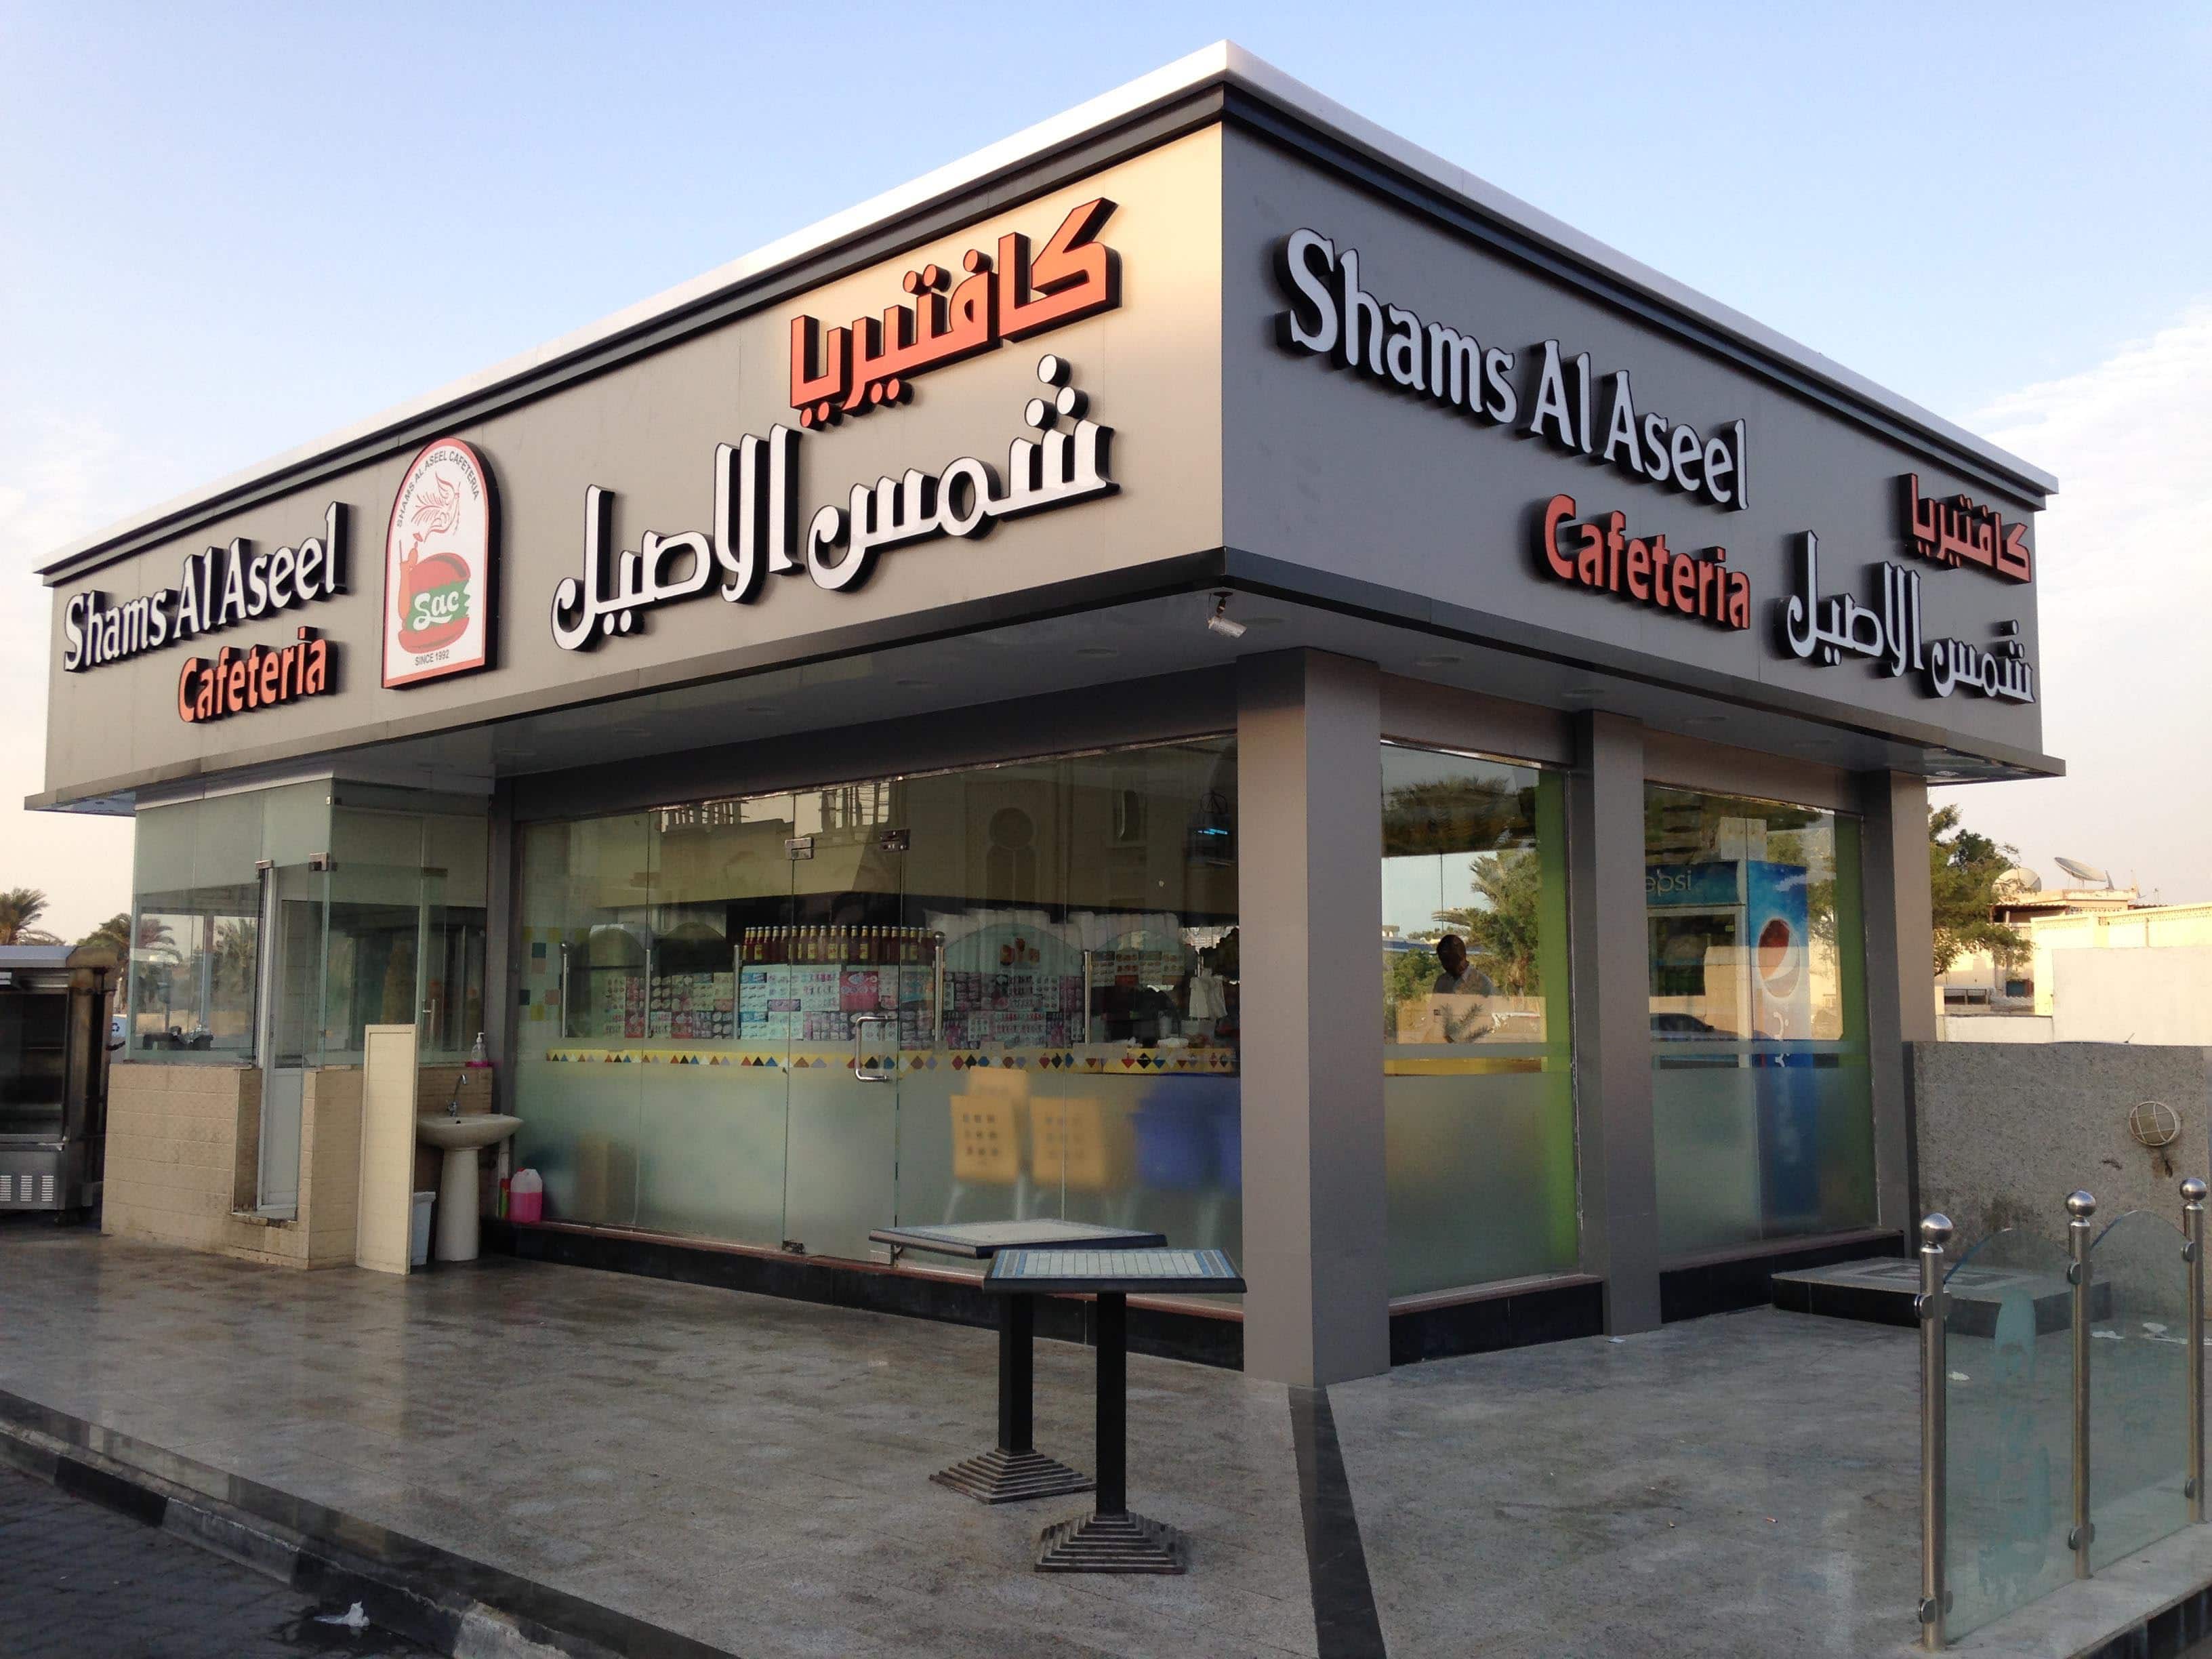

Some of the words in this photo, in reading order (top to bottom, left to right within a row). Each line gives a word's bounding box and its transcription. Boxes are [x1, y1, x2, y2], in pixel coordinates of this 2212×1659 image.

[790, 197, 1120, 428] كافتيريا
[1282, 228, 1517, 425] Shams
[1530, 340, 1593, 455] Al
[1604, 370, 1749, 511] Aseel
[397, 483, 415, 527] SHAMS
[415, 468, 425, 483] AL
[424, 451, 447, 471] ASEEL
[449, 451, 480, 501] CAFETERIA
[808, 355, 1118, 590] شمس
[1542, 494, 1750, 630] Cafeteria
[1911, 473, 2031, 583] كافتيريا
[64, 589, 166, 672] Shams
[173, 546, 214, 638] Al
[219, 501, 337, 623] Aseel
[413, 591, 459, 630] Sac
[178, 626, 327, 723] Cafeteria
[415, 653, 434, 666] SINCE
[434, 649, 450, 661] 1992
[1931, 619, 2035, 703] شمس
